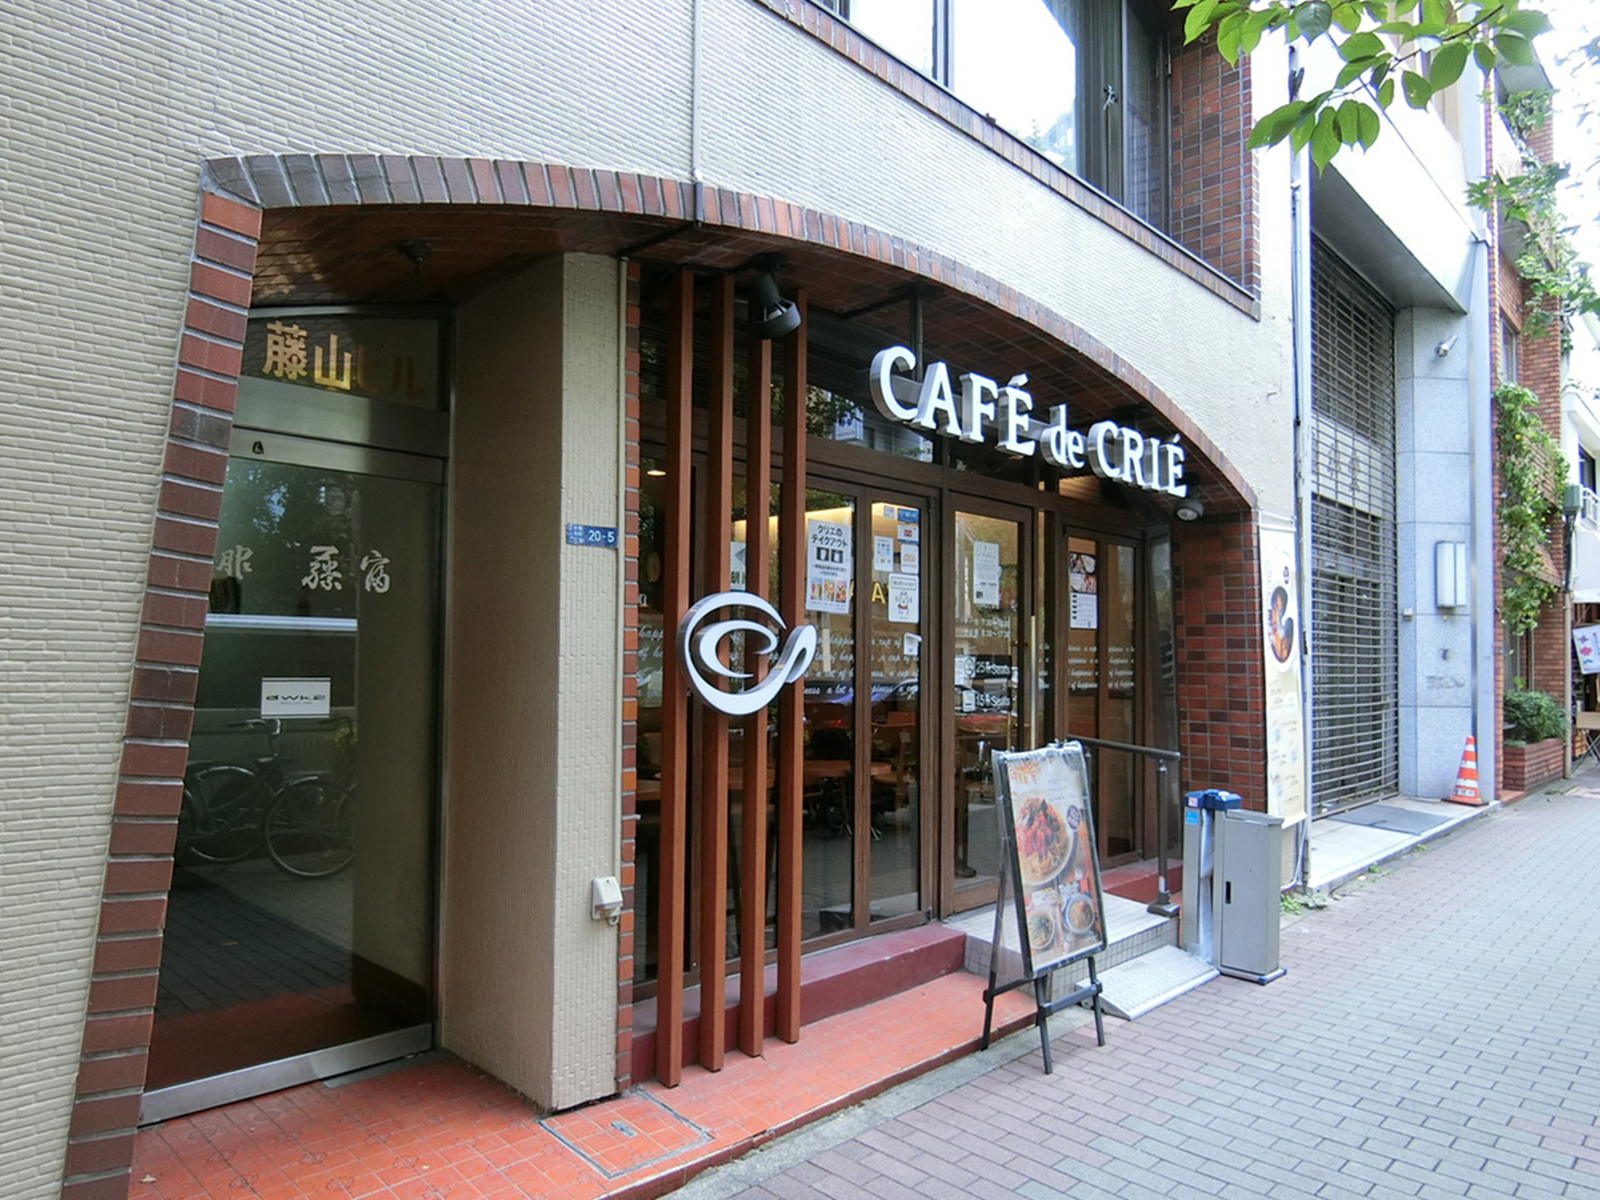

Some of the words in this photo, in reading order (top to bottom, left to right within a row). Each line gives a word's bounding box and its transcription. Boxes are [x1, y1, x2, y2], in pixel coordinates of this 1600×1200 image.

[870, 345, 1036, 457] CAFÉ
[1041, 403, 1085, 469] de
[1088, 419, 1187, 498] CRIÉ
[588, 531, 615, 543] 20-5
[817, 524, 843, 537] クリエの
[811, 535, 848, 548] テイクアウト
